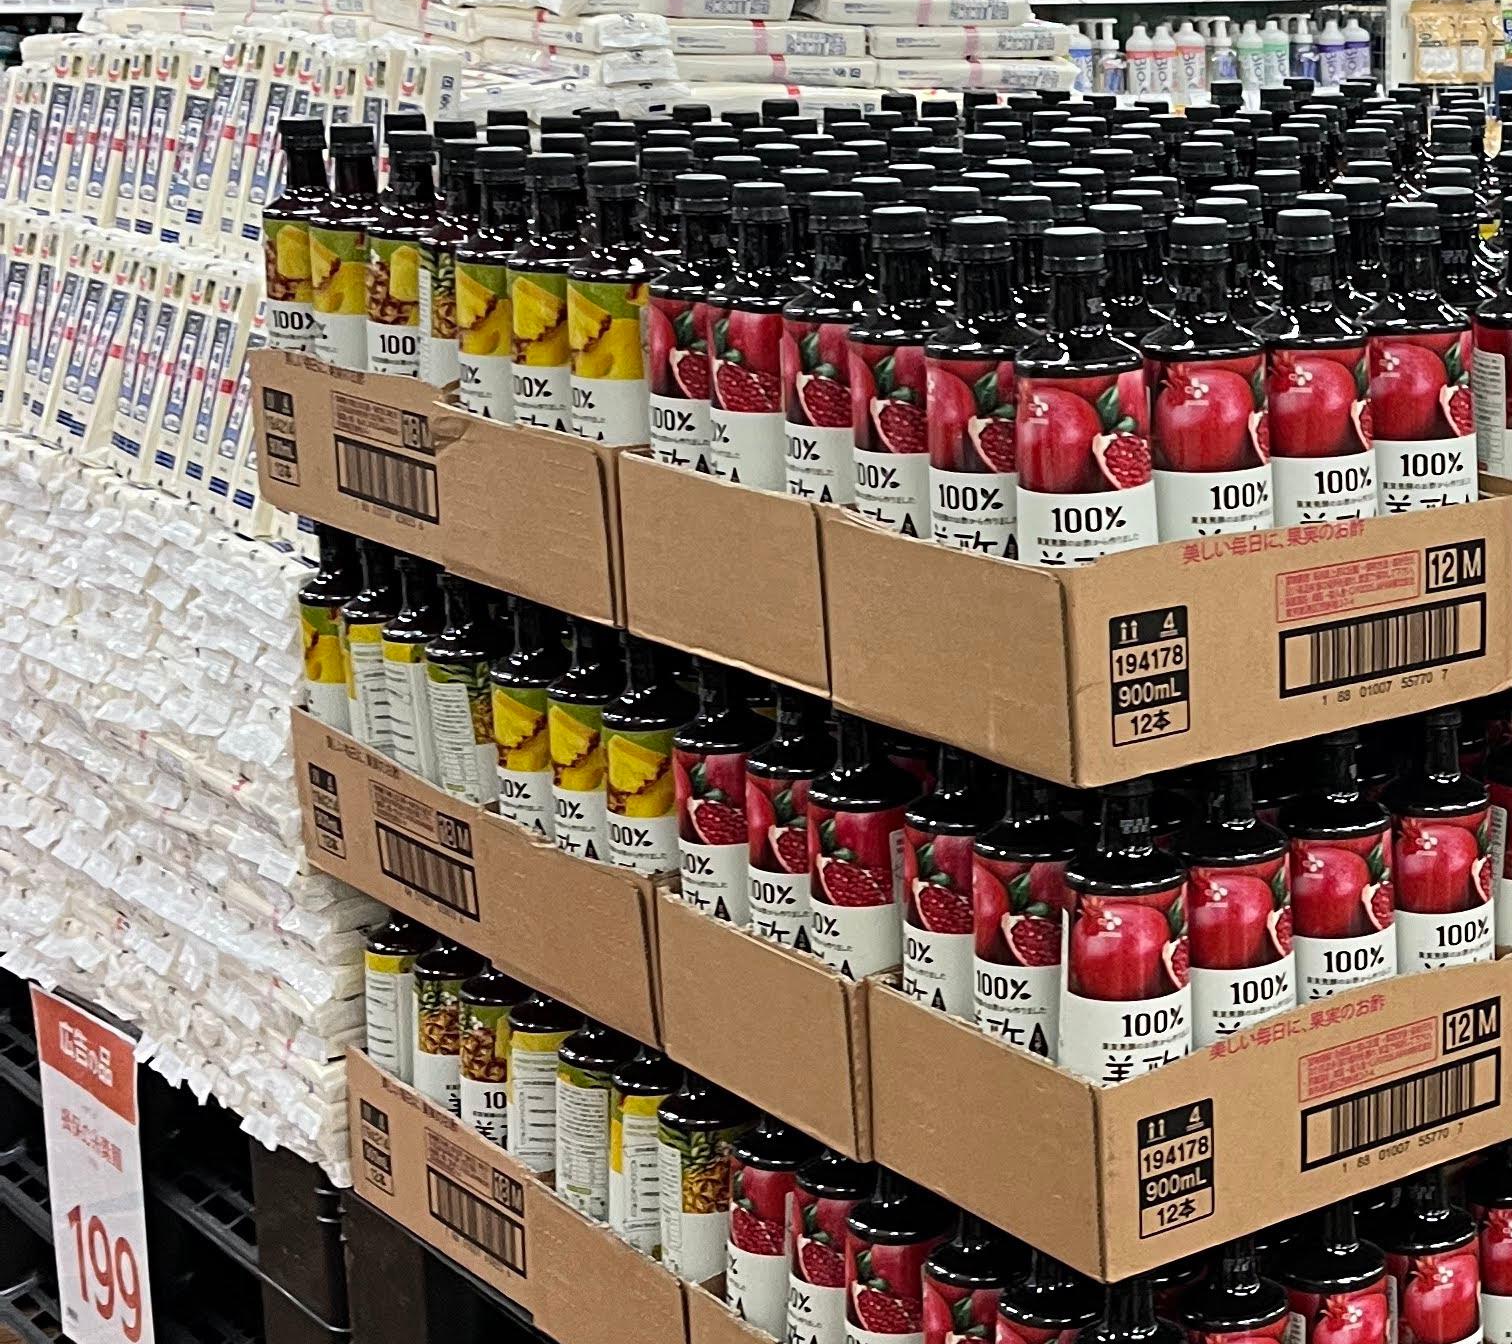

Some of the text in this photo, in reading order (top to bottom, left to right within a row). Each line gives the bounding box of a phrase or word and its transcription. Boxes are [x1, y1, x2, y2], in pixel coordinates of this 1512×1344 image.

[1400, 452, 1464, 478] 100%
[1210, 480, 1268, 510] 100%
[1314, 466, 1373, 495] 100%
[938, 484, 1004, 512] 100%
[1051, 506, 1127, 534] 100%
[1160, 610, 1178, 632] 4
[1116, 645, 1184, 677] 194178
[1118, 680, 1181, 707] 900mL
[1401, 673, 1434, 691] 55770
[1130, 711, 1171, 736] 12本
[1436, 919, 1490, 948] 100%
[1323, 946, 1385, 973] 100%
[975, 970, 1031, 1001] 100%
[1230, 973, 1289, 1006] 100%
[1121, 1005, 1184, 1038] 100%
[59, 1020, 113, 1087] 広告の品
[1187, 1106, 1202, 1127] 4
[1142, 1136, 1209, 1174] 194178
[1145, 1168, 1206, 1201] 900mL
[1157, 1199, 1196, 1227] 12本
[67, 1204, 141, 1344] 199
